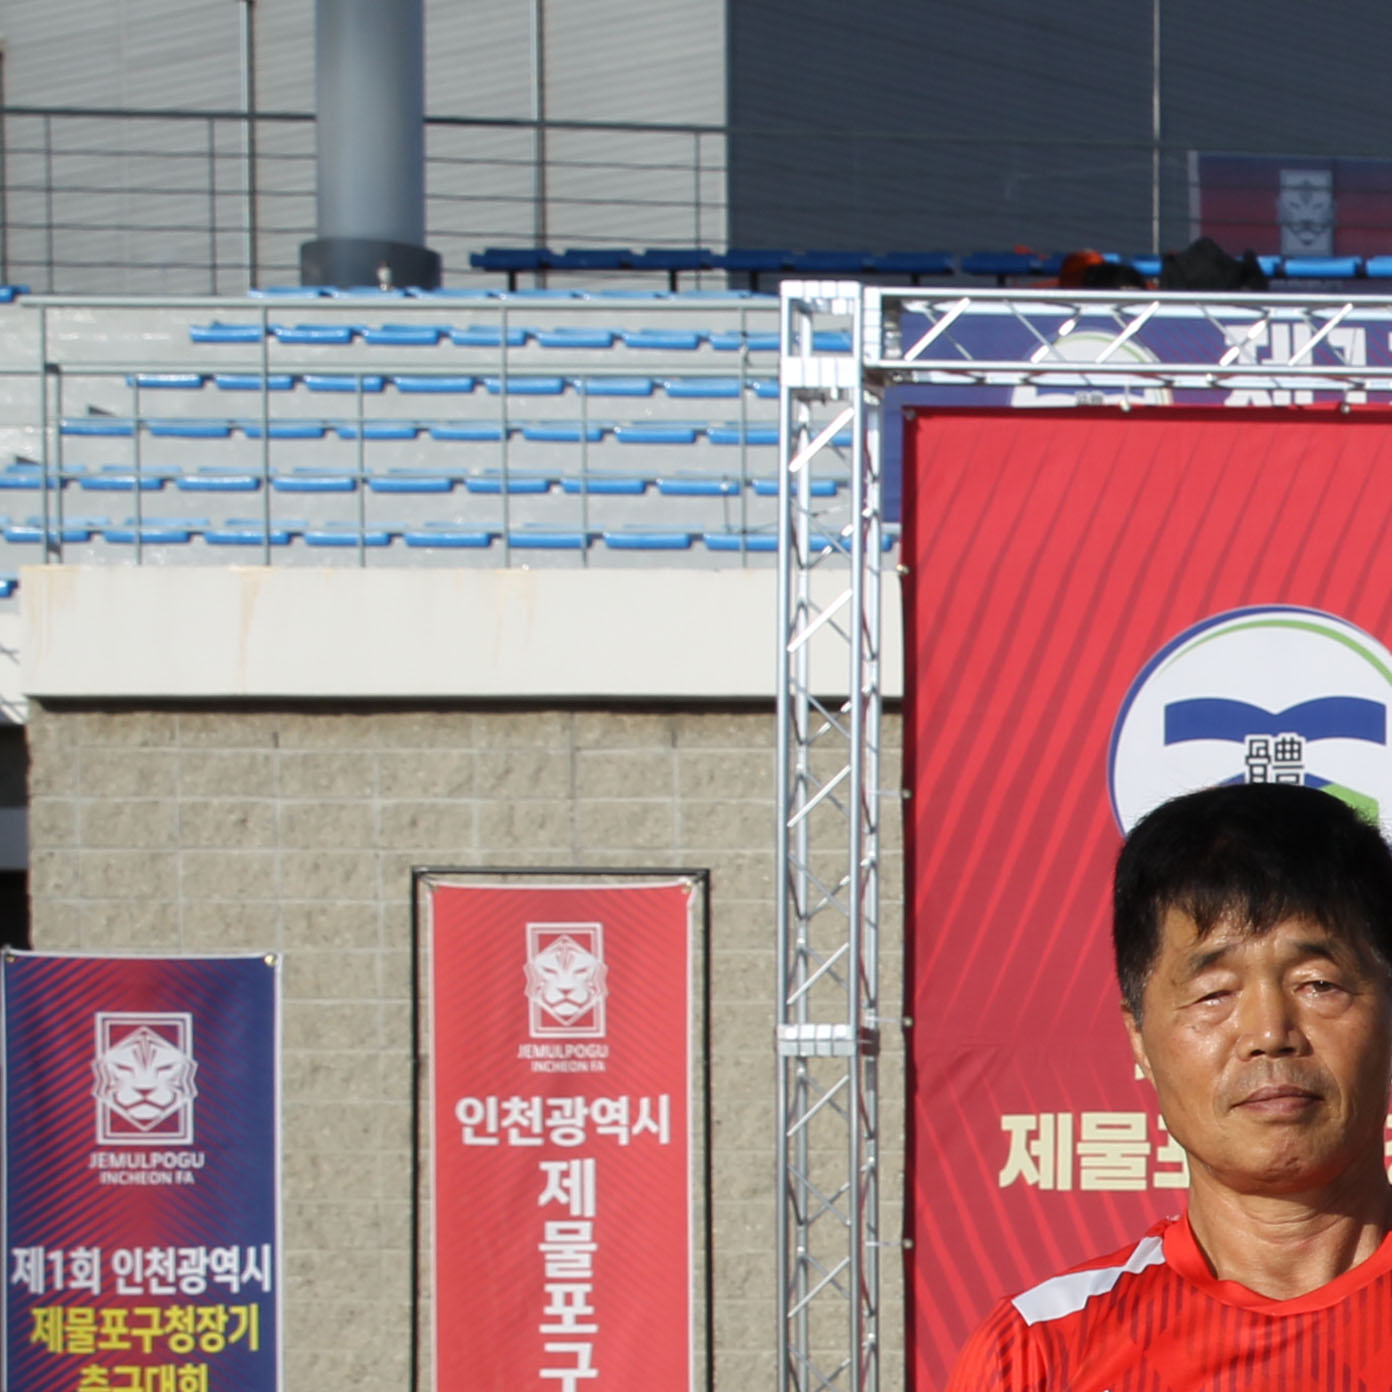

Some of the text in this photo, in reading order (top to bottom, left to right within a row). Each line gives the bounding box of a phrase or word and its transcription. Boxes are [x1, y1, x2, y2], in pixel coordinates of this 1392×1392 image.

[517, 1043, 610, 1060] JEMULPOGU
[531, 1060, 588, 1073] INCHEON
[454, 1093, 671, 1148] 인천광역시
[89, 1152, 205, 1170] JEMULPOGU
[100, 1171, 195, 1185] INCHEON FA
[11, 1243, 272, 1296] 제1회 인천광역시
[30, 1303, 260, 1354] 제물포구청장기
